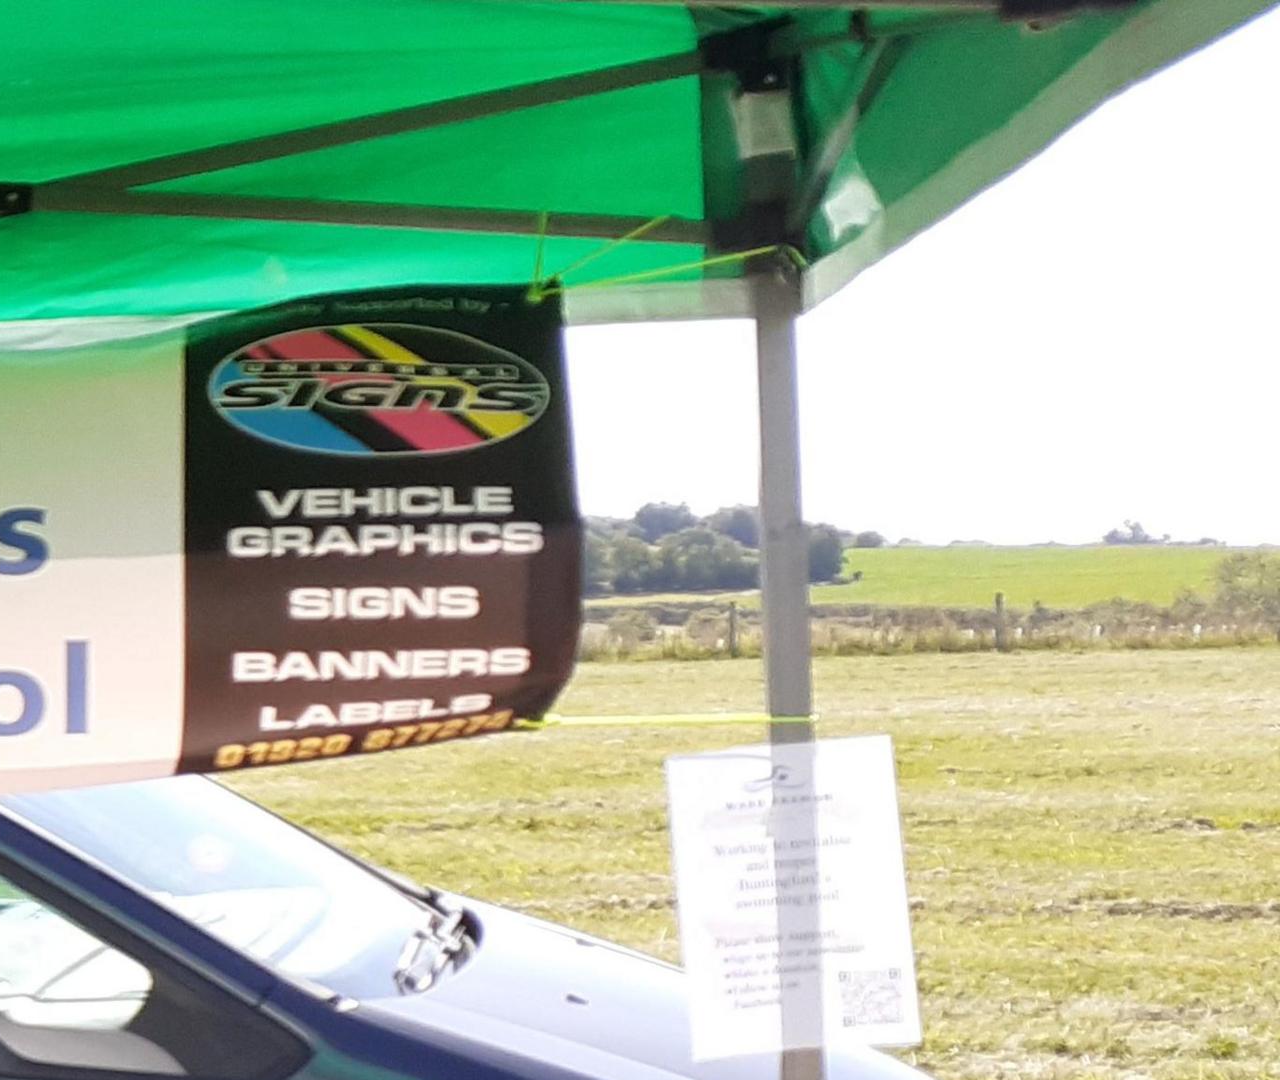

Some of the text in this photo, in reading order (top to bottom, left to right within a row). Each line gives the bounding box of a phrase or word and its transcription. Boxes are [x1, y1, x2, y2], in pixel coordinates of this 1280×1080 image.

[244, 361, 518, 377] UNIVERSAL
[257, 487, 514, 520] VEHICLE
[226, 522, 544, 557] GRAPHICS
[288, 586, 480, 620] SIGNS
[232, 647, 531, 682] BANNERS
[260, 694, 493, 731] LABELS
